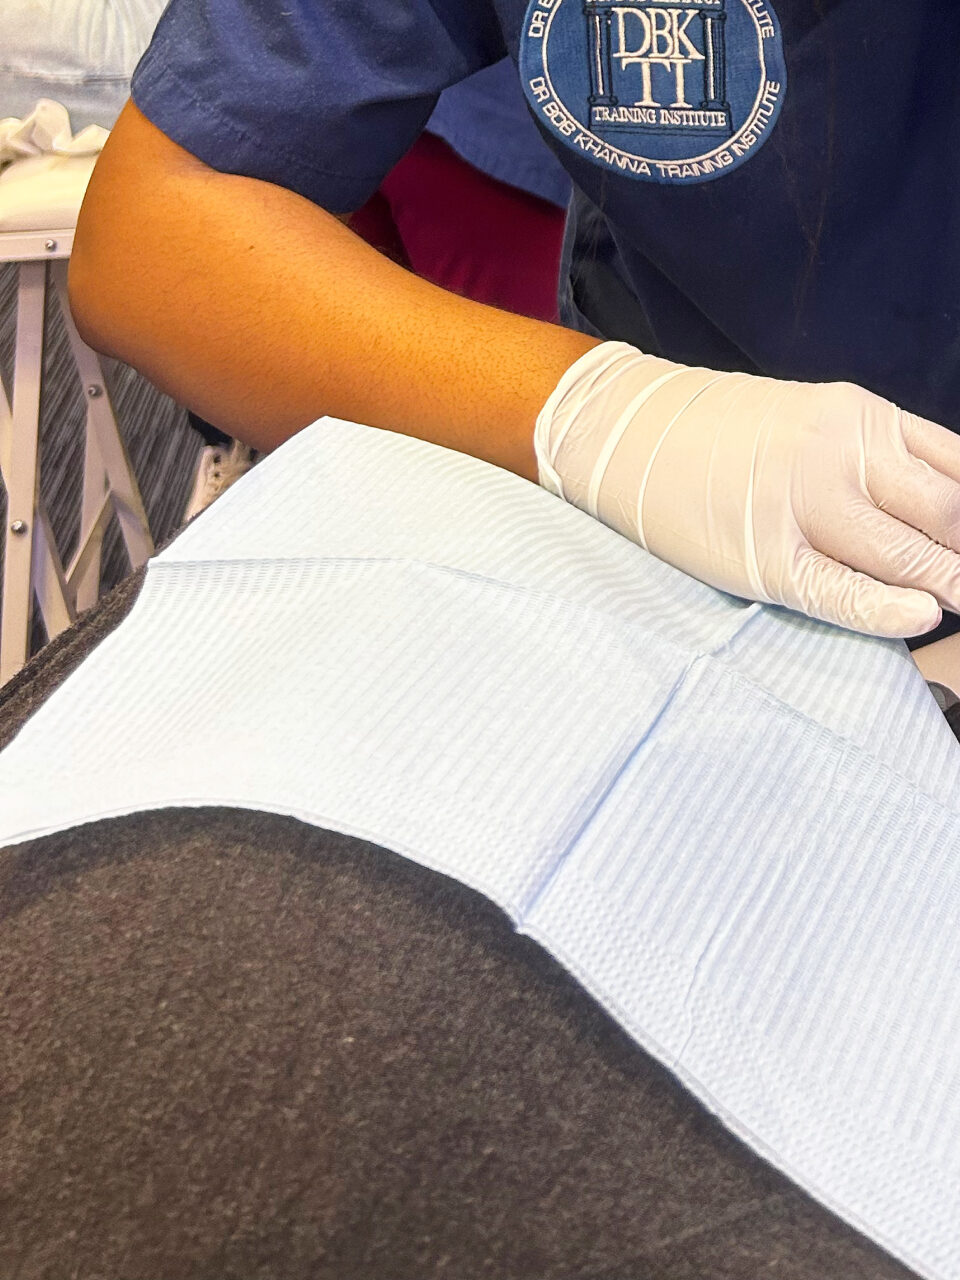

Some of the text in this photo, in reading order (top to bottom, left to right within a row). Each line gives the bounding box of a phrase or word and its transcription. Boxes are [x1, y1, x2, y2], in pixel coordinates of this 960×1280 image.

[528, 9, 549, 38] DR
[612, 8, 705, 59] DBK
[529, 76, 780, 178] DR BOB KHANNA TRAINING INSTITUTE
[593, 108, 727, 126] TRAINING INSTITUTE
